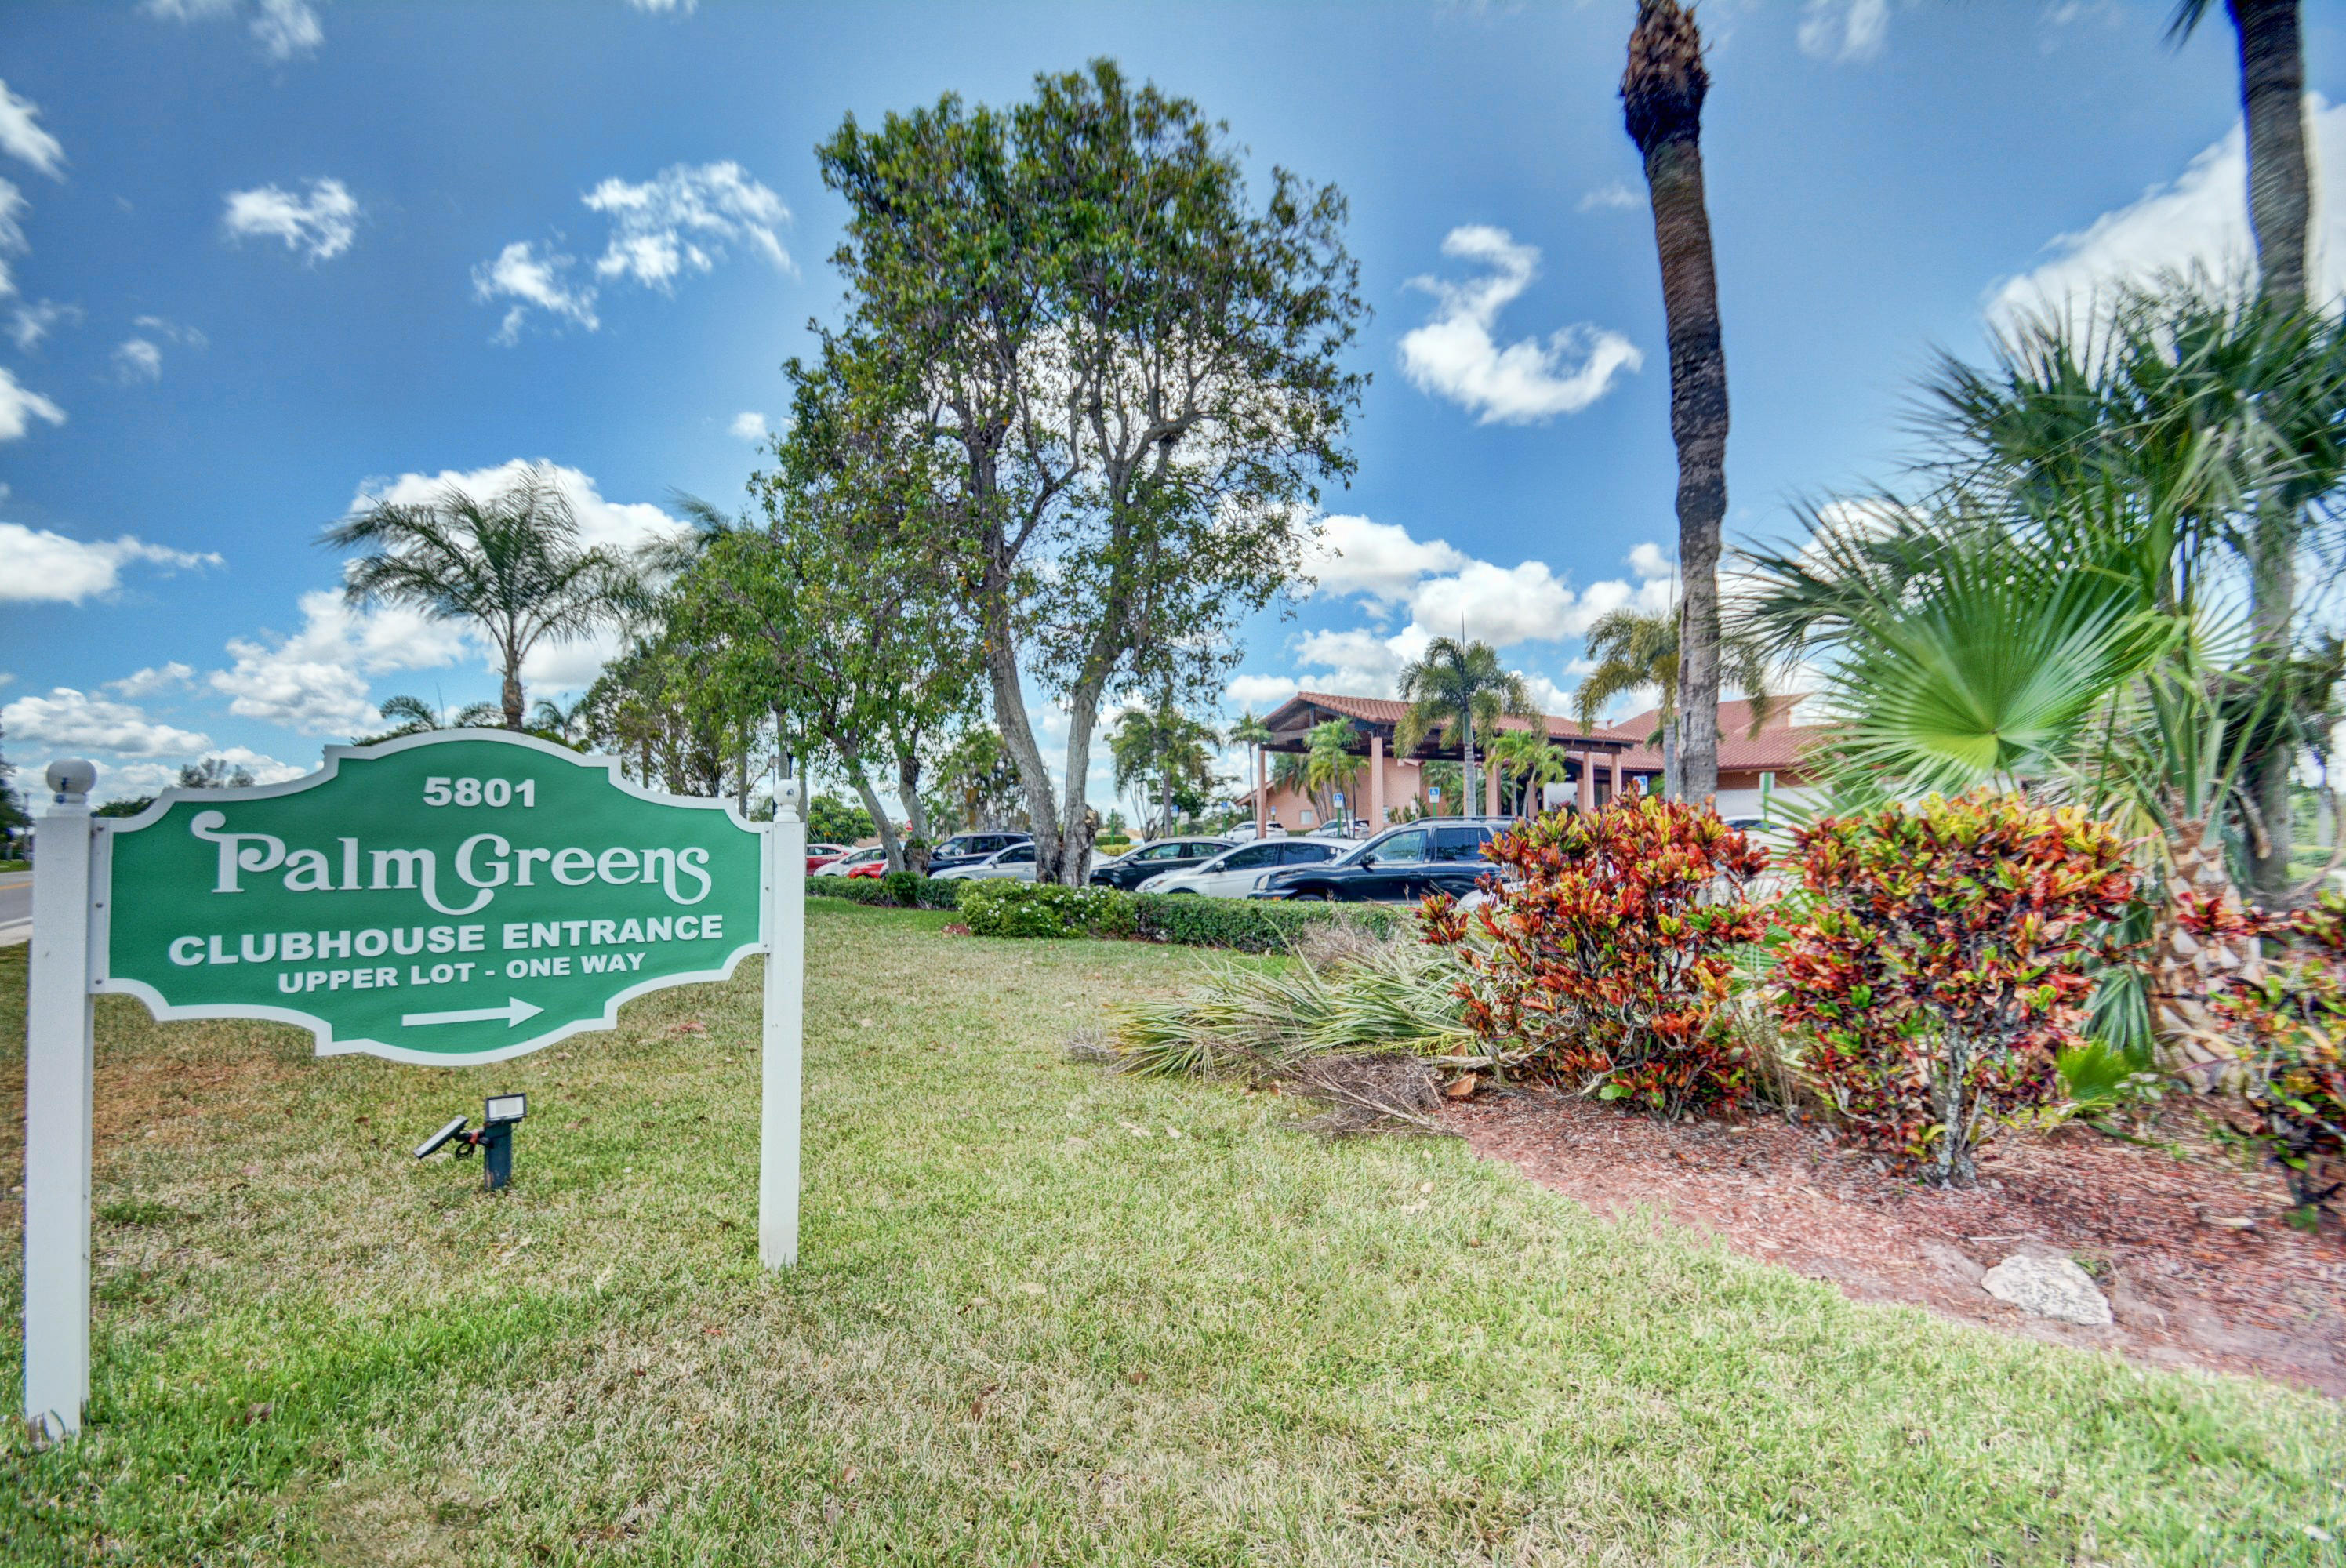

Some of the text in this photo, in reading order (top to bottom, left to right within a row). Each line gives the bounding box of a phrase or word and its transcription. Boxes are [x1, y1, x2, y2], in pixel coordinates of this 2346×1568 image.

[423, 777, 536, 808] 5801
[191, 811, 712, 916] Palm Greens
[169, 914, 723, 967] CLUBHOUSE ENTRANCE
[278, 967, 398, 994] UPPER
[411, 962, 476, 985] LOT
[506, 956, 571, 980] ONE
[580, 952, 646, 975] WAY
